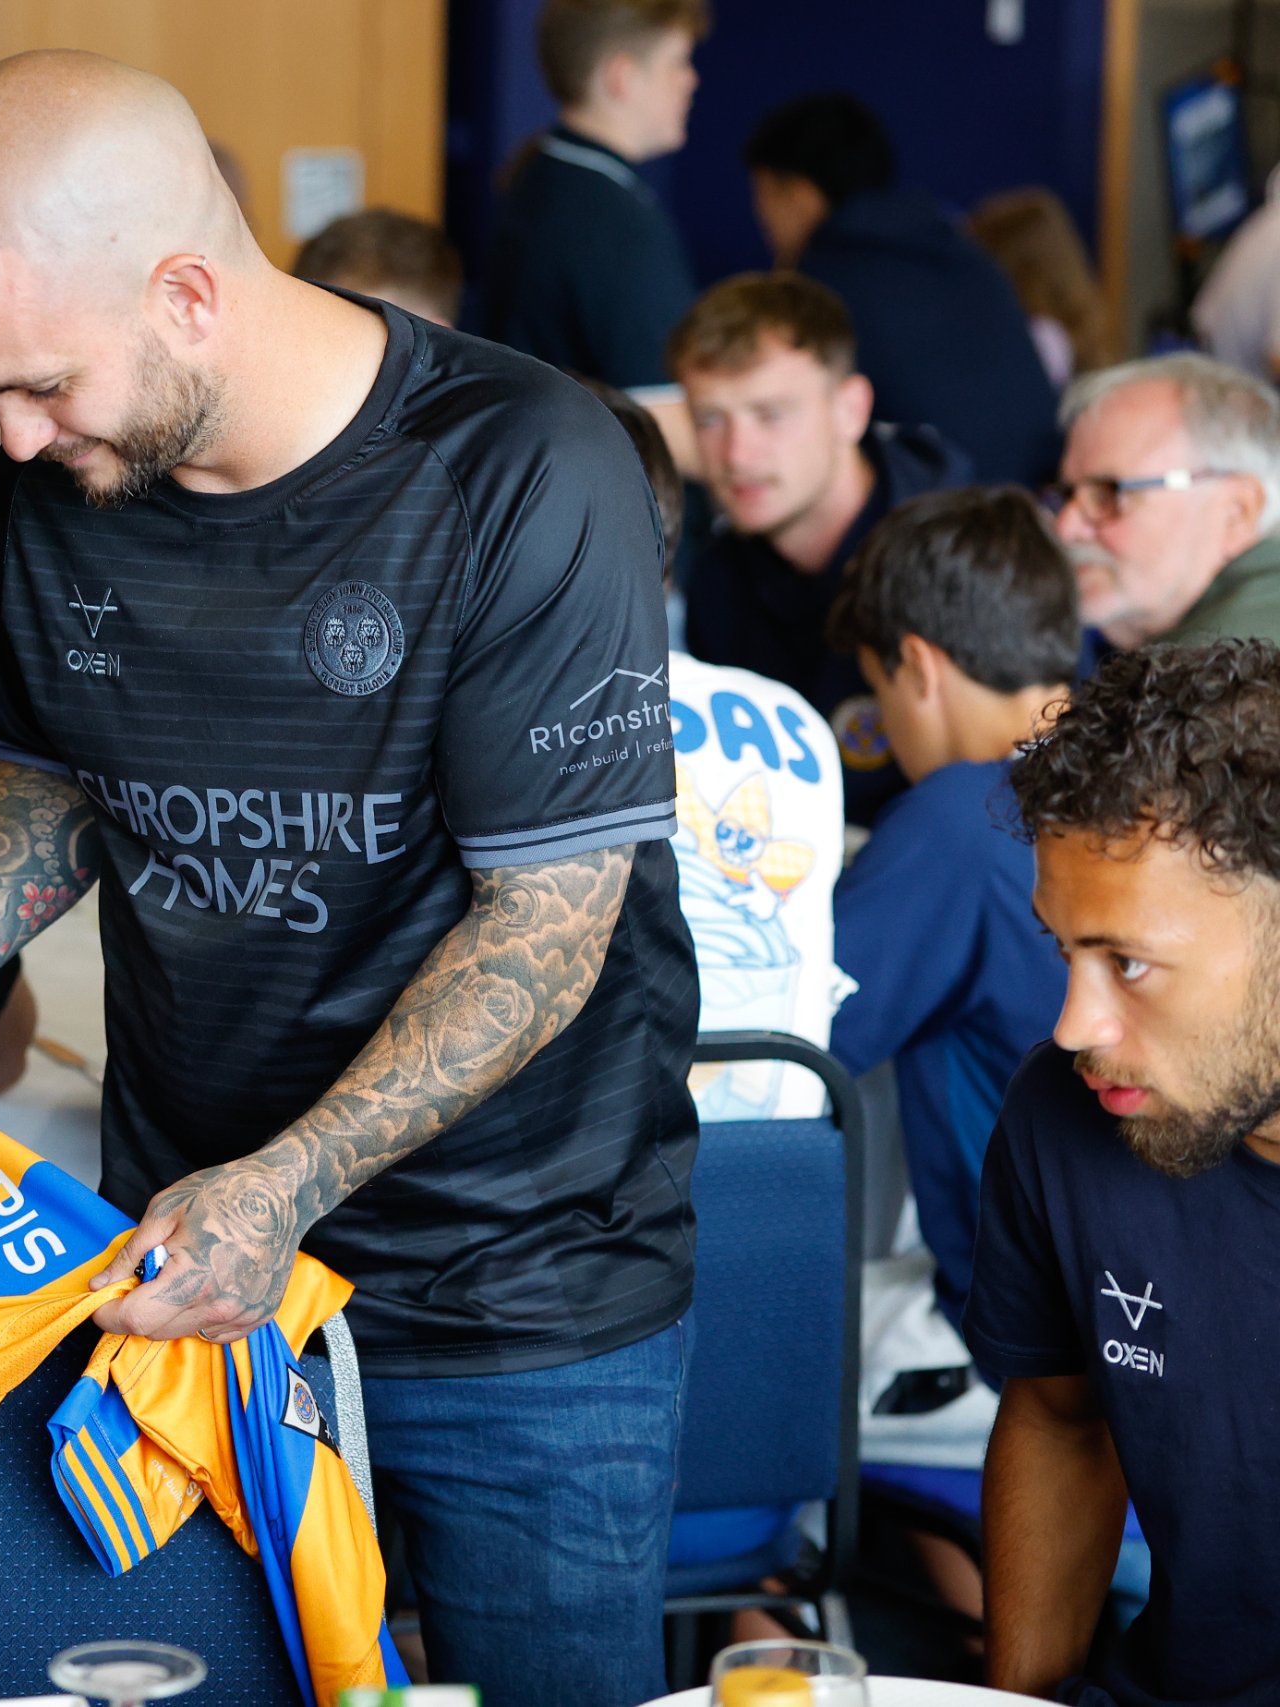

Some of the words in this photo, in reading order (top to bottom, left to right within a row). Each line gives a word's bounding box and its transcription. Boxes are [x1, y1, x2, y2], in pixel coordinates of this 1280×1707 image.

[67, 649, 120, 677] OXEN
[560, 759, 588, 776] new
[592, 747, 629, 768] build
[128, 848, 329, 934] HOMES
[1102, 1339, 1165, 1378] OXEN
